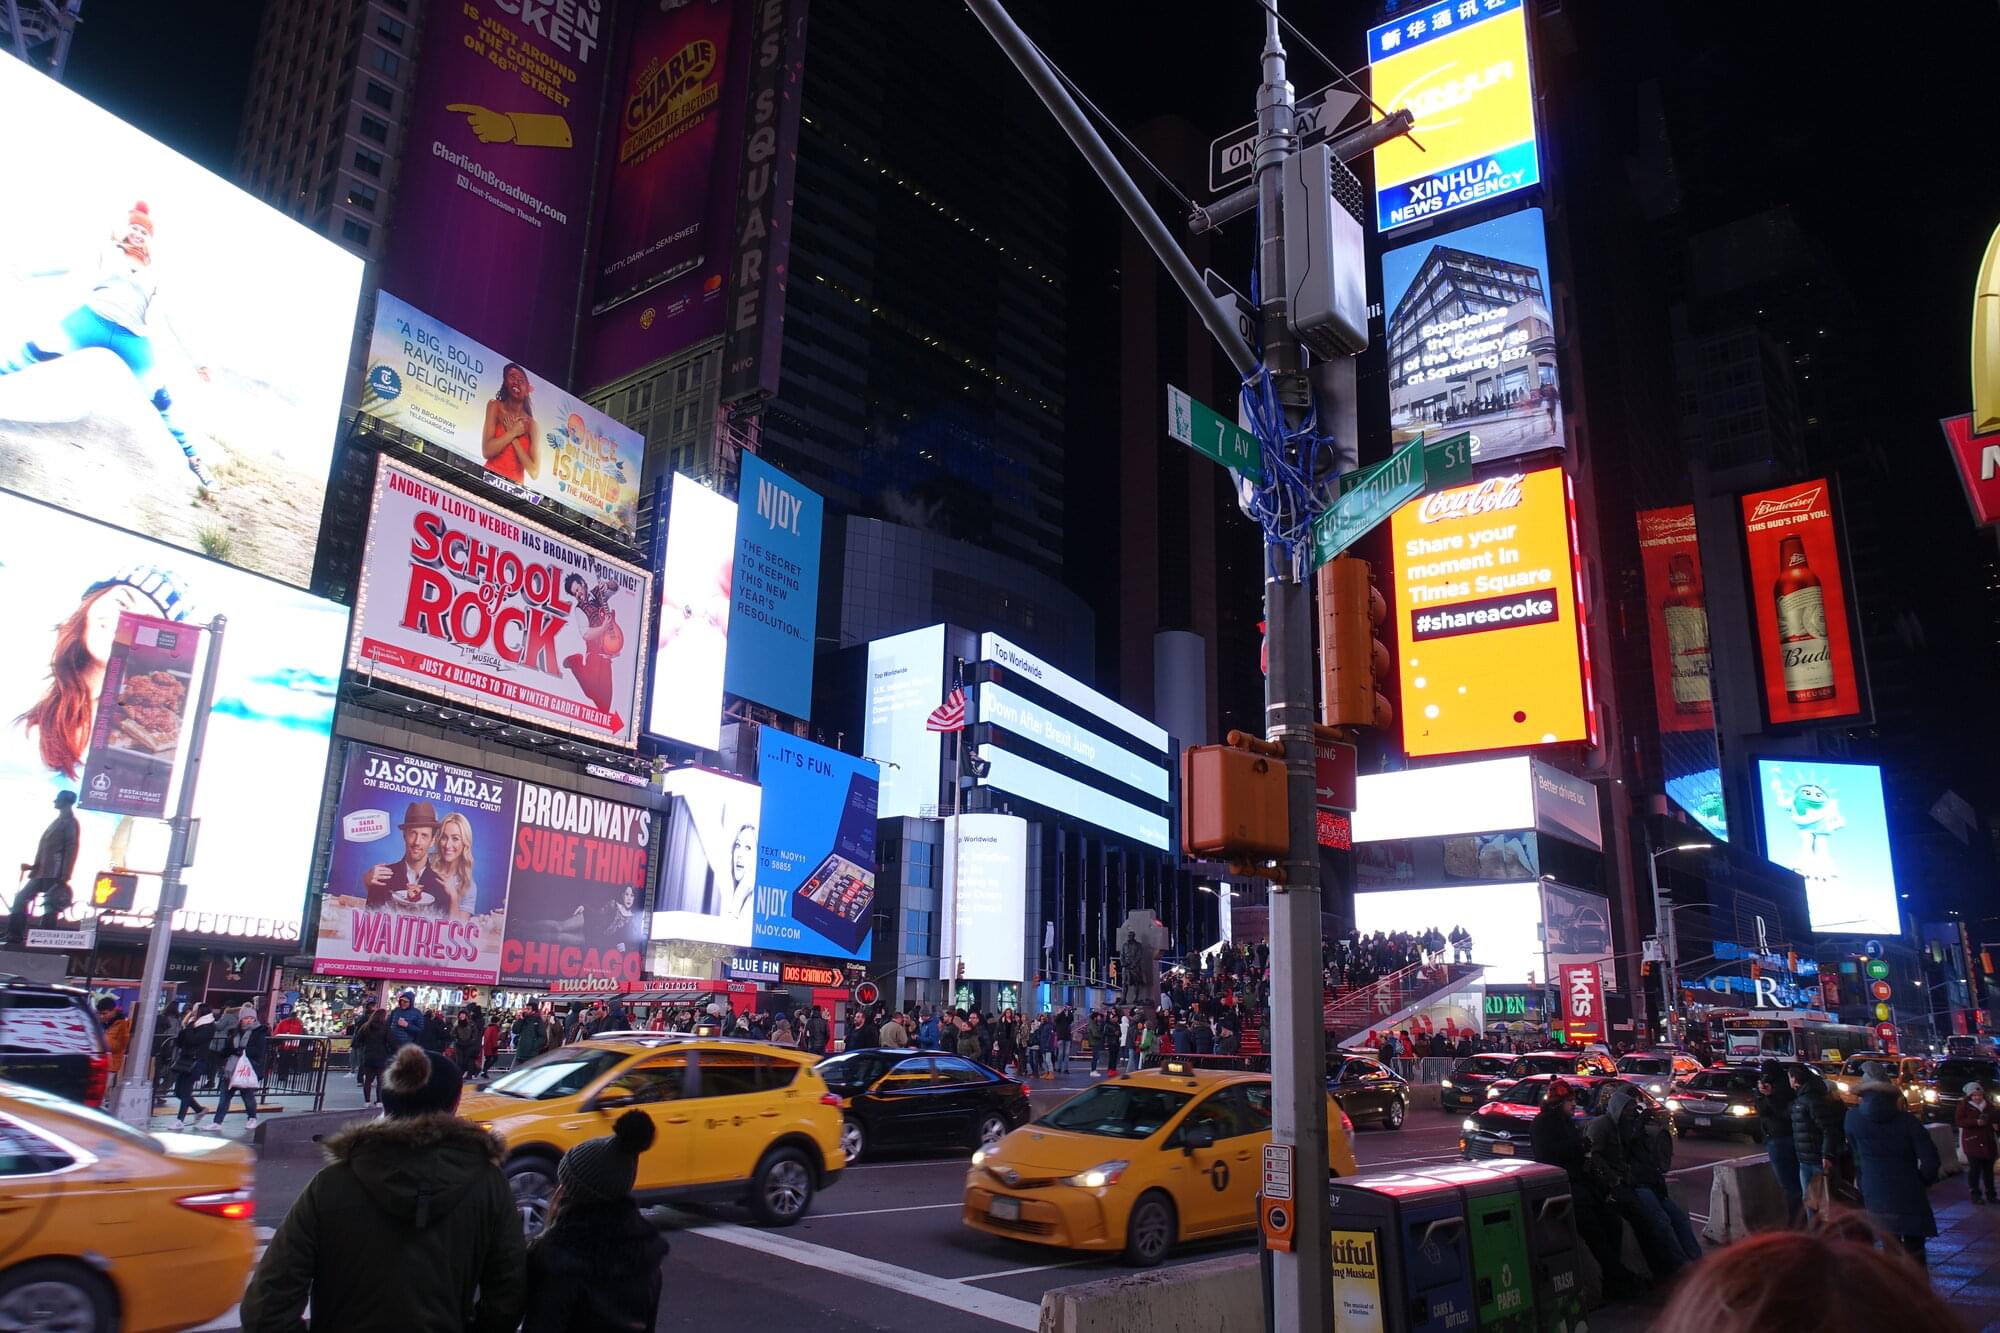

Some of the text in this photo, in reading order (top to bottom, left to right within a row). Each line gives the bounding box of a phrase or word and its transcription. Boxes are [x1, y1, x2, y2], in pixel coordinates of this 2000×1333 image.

[464, 3, 577, 83] IS JUST AROUND
[478, 26, 562, 89] THE CORNER
[463, 35, 571, 108] ON STREET
[625, 40, 717, 132] CHARLIE
[681, 86, 717, 118] FACTORY
[1229, 106, 1323, 167] ON AY
[432, 141, 567, 225] CharlieOnBroadway.com
[1390, 168, 1526, 224] NEWS AGENCY
[1409, 160, 1503, 204] XINHUA
[735, 88, 776, 332] SQUARE
[626, 248, 645, 266] DARK
[655, 222, 701, 250] SEMI-SWEET
[1422, 307, 1508, 338] Experience
[1427, 322, 1506, 351] the power
[402, 340, 478, 390] RAVISHING
[447, 344, 485, 375] BOLD
[1403, 329, 1529, 372] of the Galaxy S8
[1407, 347, 1532, 385] at Samsung 837.
[410, 403, 457, 429] ON BROADWAY
[1214, 420, 1249, 459] 7 Av
[1445, 441, 1466, 469] St
[552, 448, 620, 503] ISLAND
[1362, 452, 1412, 511] Equity
[1757, 497, 1814, 516] Budweiser
[441, 495, 476, 523] LLOYD
[478, 511, 520, 539] WEBBER
[521, 530, 542, 552] HAS
[543, 540, 594, 573] BROADWAY
[1747, 521, 1766, 533] THIS
[1767, 517, 1791, 529] BUD'S
[1792, 514, 1808, 524] FOR
[742, 538, 802, 577] THE SECRET
[1406, 525, 1517, 557] Share your
[411, 511, 573, 614] SCHOOL
[741, 555, 800, 592] TO KEEPING
[1407, 548, 1520, 580] moment in
[479, 582, 511, 615] of
[739, 585, 774, 611] YEAR'S
[740, 569, 788, 601] THIS NEW
[1408, 568, 1552, 604] Times Square
[400, 562, 570, 678] ROCK
[1416, 598, 1553, 633] #shareacoke
[471, 654, 502, 667] MUSICAL
[884, 666, 908, 678] Worldwide
[994, 643, 1042, 680] Top Worldwide
[419, 657, 612, 727] JUST 4 BLOCKS TO THE WINTER GARDEN THEATRE
[989, 694, 1096, 762] Down After Brexit Jump
[364, 757, 503, 803] JASON MRAZ
[443, 764, 473, 779] WINNER
[808, 757, 835, 778] FUN.
[119, 788, 161, 798] RESTAURANT
[363, 777, 502, 813] ON BROADWAY FOR 10 WEEKS ONLY!
[1538, 776, 1577, 802] Better drives
[521, 783, 651, 847] BROADWAY'S
[516, 826, 648, 890] SURE THING
[760, 845, 806, 864] TEXT NJOY11
[760, 857, 770, 868] TO
[757, 884, 788, 921] NJOY
[351, 909, 480, 962] WAITRESS
[755, 923, 801, 940] NJOY.COM
[169, 963, 199, 973] DRINK
[373, 966, 396, 974] THEATRE
[501, 939, 642, 982] CHICAGO
[732, 957, 780, 974] BLUE FIN
[784, 967, 800, 981] DOS
[801, 968, 832, 984] CAMINOS
[559, 973, 619, 991] nuchas
[863, 989, 873, 1000] W
[1568, 968, 1592, 1018] tkts
[1754, 976, 1789, 1008] R
[1214, 1166, 1226, 1188] T
[1345, 1267, 1376, 1280] Musical
[1552, 1271, 1575, 1293] TRASH
[1432, 1300, 1448, 1318] CANS
[1497, 1287, 1522, 1311] PAPER
[1445, 1309, 1470, 1329] BOTTLES
